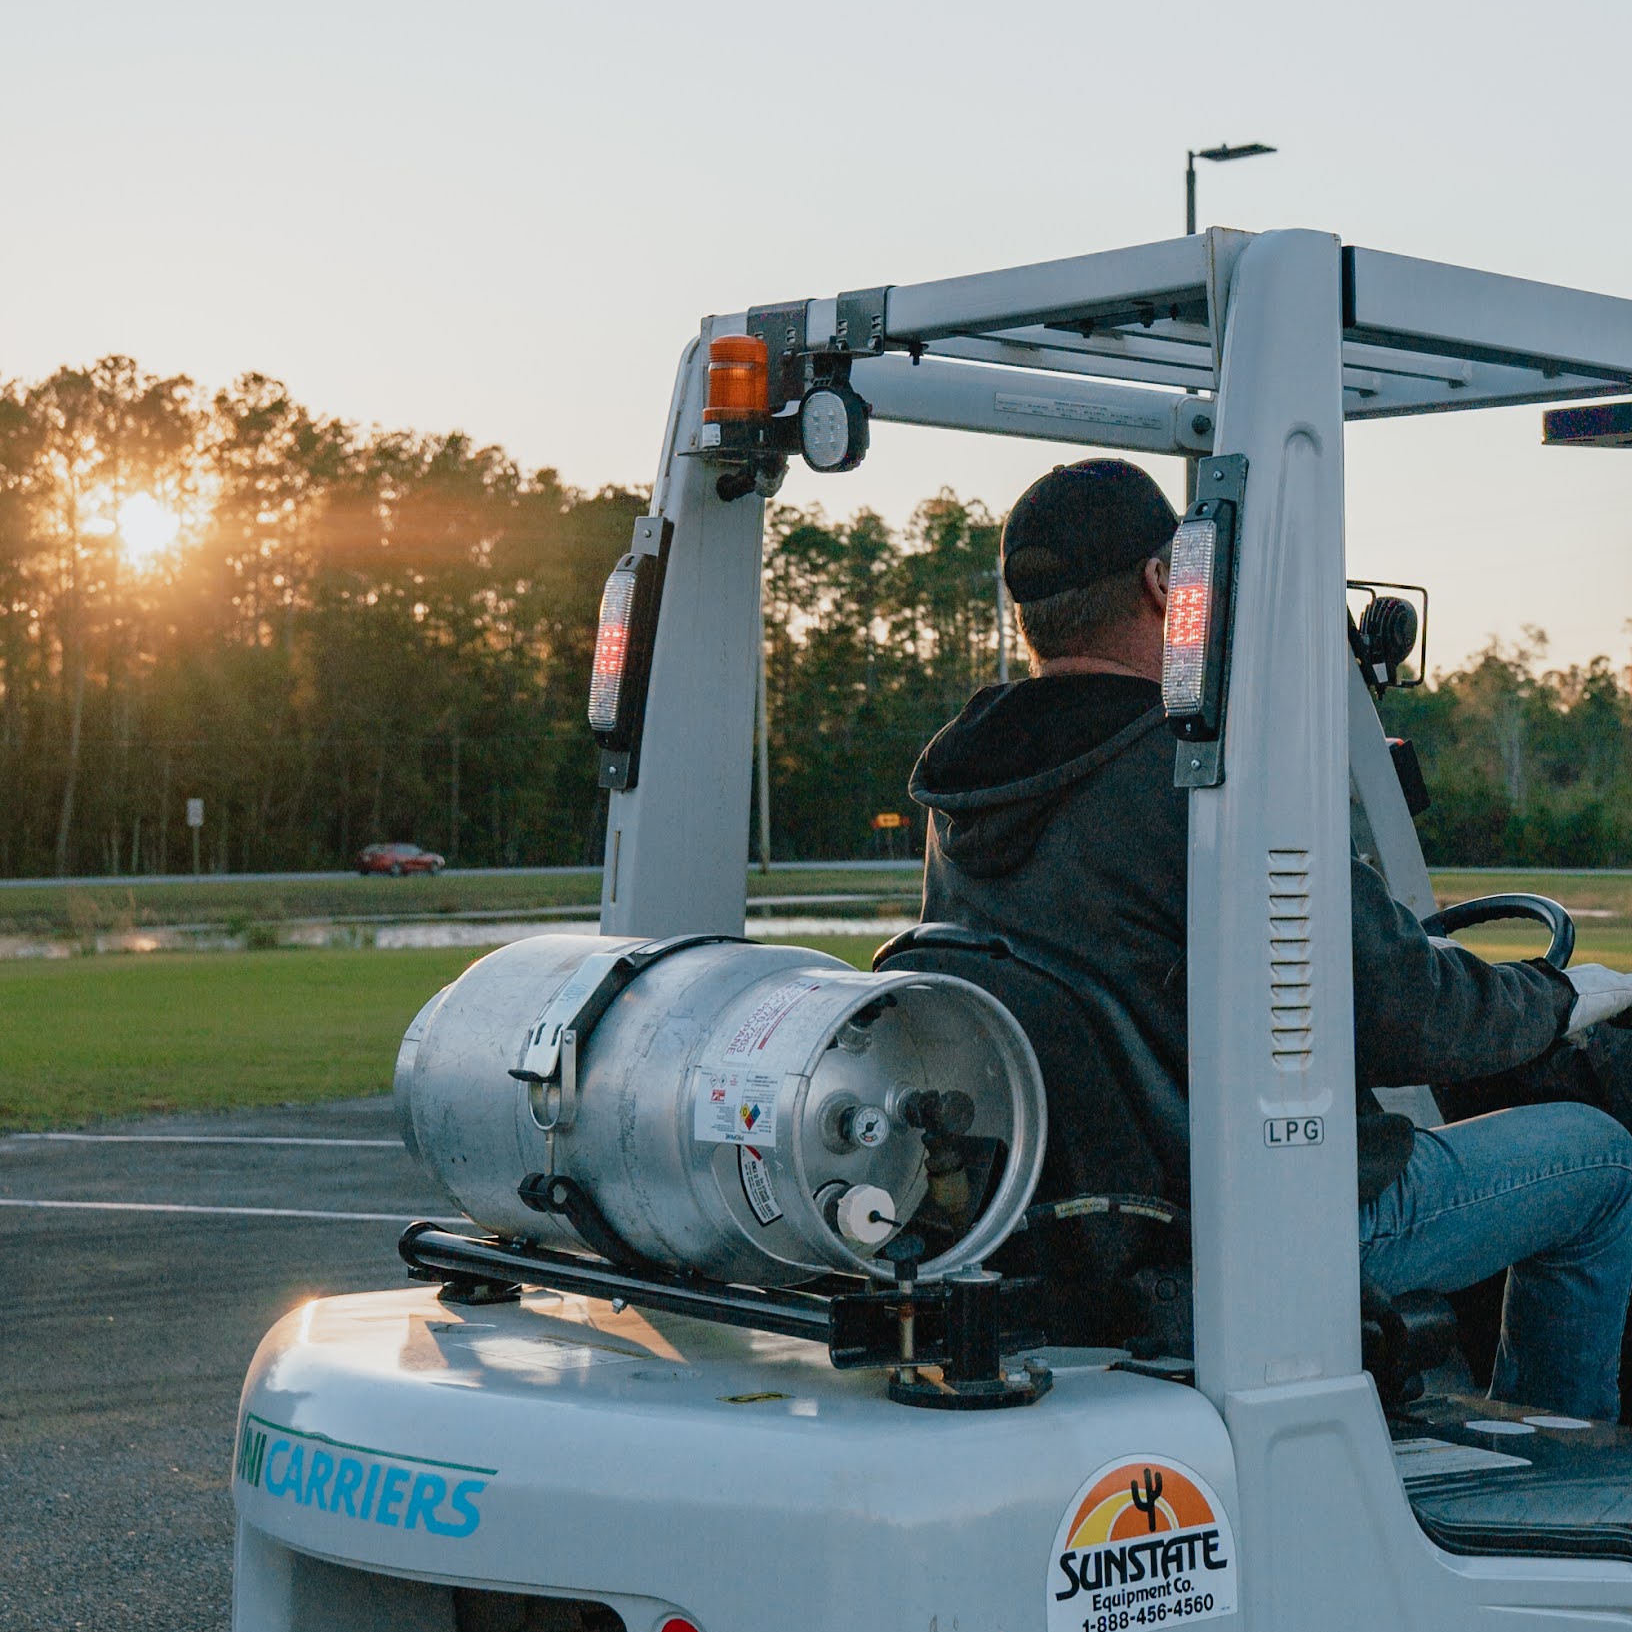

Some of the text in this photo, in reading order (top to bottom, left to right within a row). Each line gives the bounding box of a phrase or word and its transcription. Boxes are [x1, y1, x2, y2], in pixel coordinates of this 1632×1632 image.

[1269, 1120, 1320, 1142] LPG
[1055, 1529, 1228, 1602] SUNSTATE
[1092, 1576, 1195, 1614] Equipment Co.
